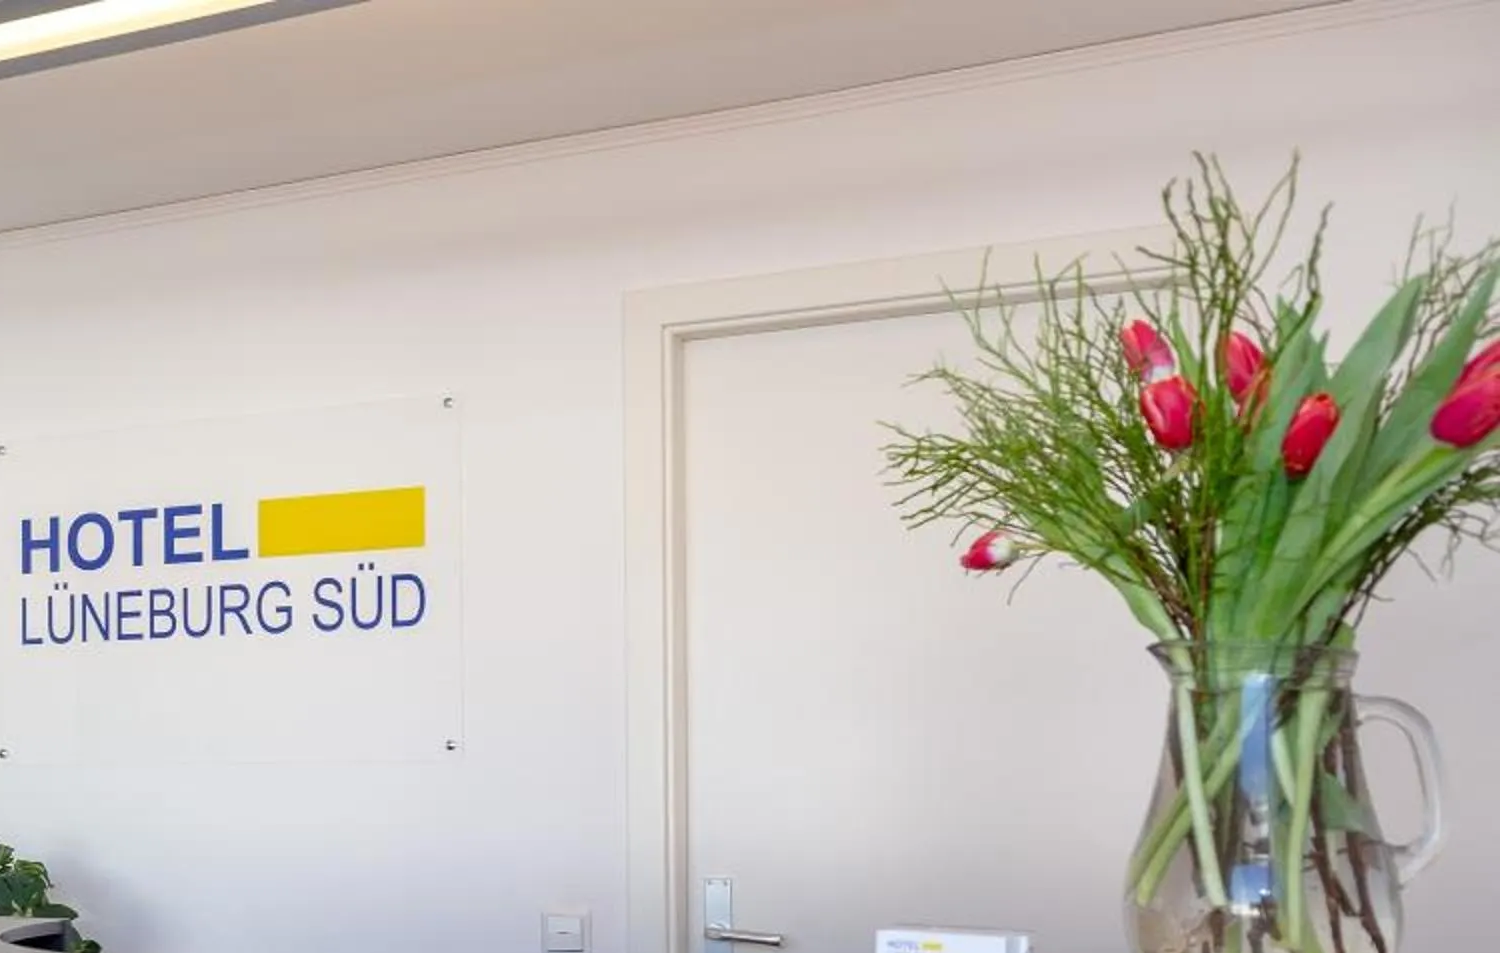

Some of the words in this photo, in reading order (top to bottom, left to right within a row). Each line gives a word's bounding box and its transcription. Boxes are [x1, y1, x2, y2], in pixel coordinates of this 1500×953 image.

[20, 503, 249, 575] HOTEL
[20, 580, 294, 646] LÜNEBURG
[312, 562, 428, 633] SÜD
